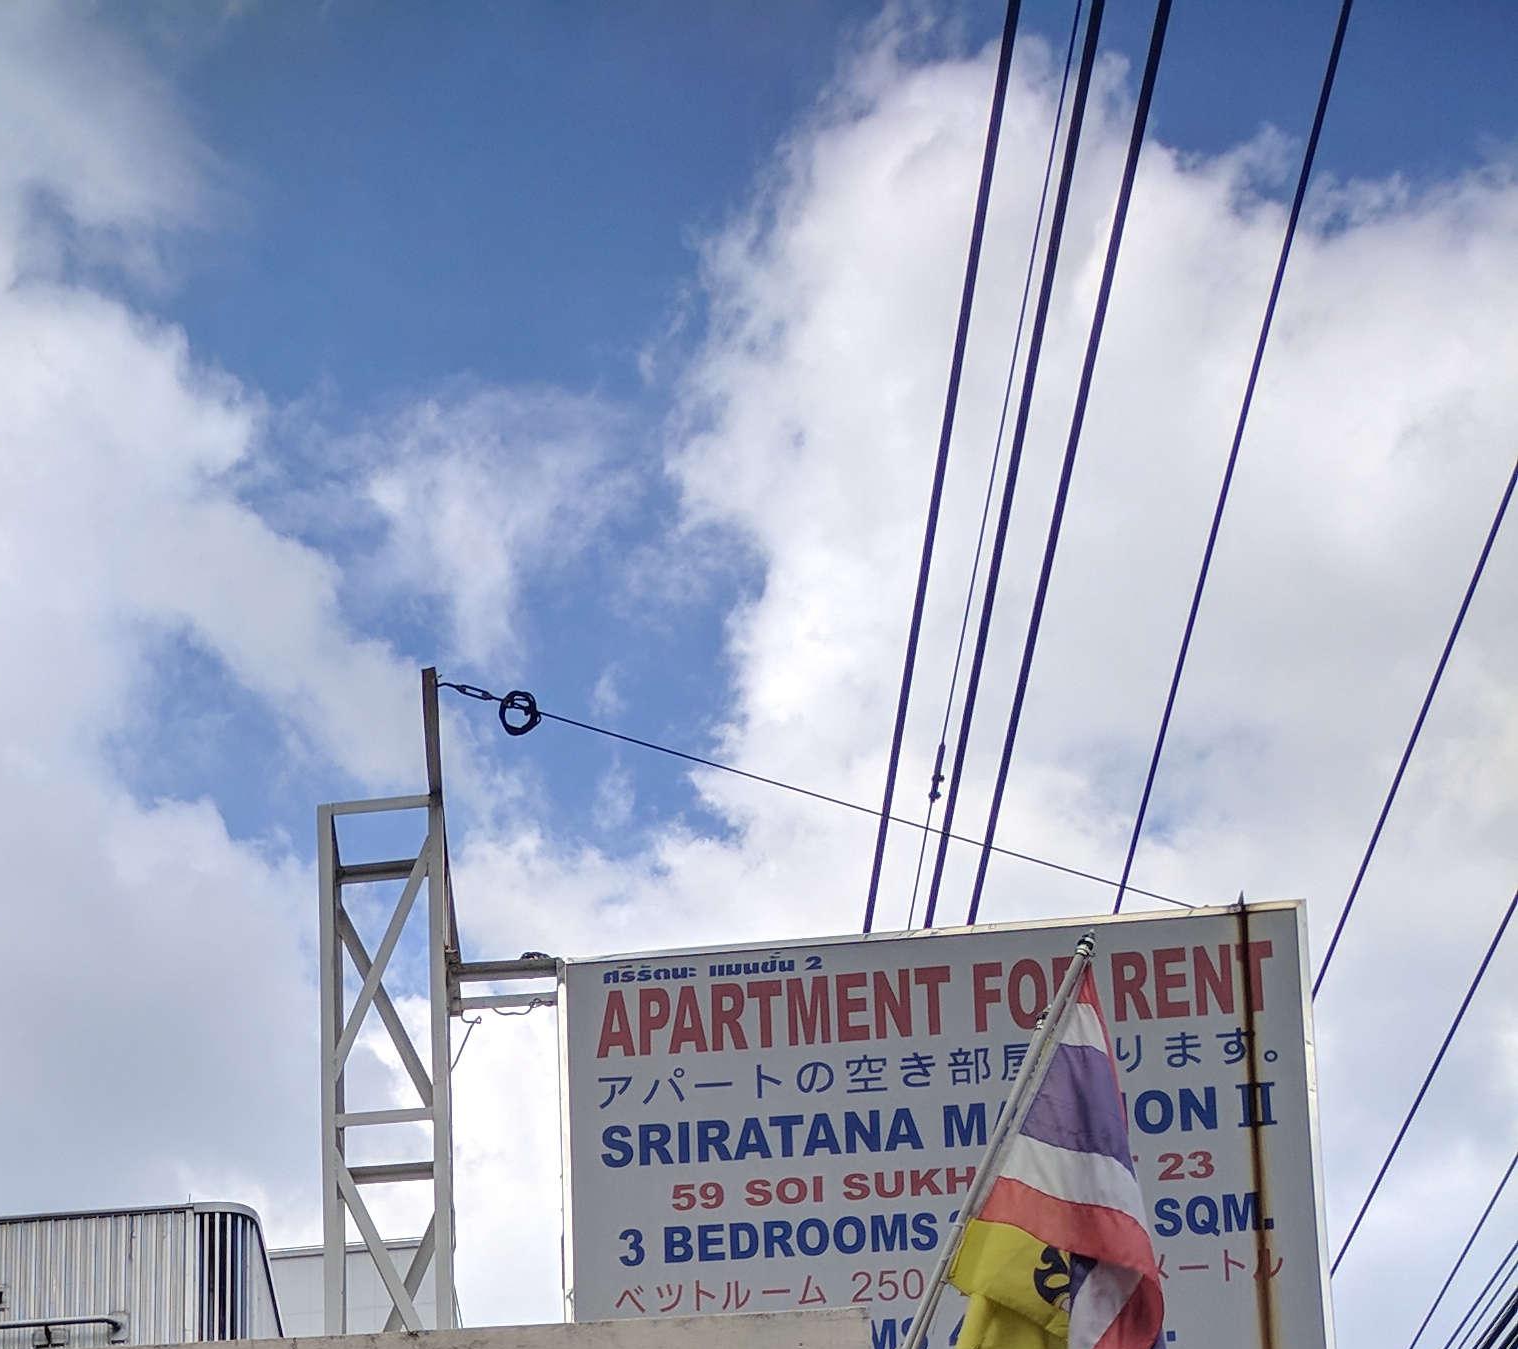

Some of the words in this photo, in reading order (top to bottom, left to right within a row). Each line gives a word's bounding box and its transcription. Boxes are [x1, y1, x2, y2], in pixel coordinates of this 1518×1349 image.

[804, 955, 823, 971] 2
[596, 965, 951, 1059] APARTMENT
[1110, 940, 1273, 1023] RENT
[600, 1107, 924, 1168] SRIRATANA
[671, 1182, 725, 1212] 59
[744, 1175, 824, 1207] SOI
[1157, 1151, 1216, 1181] 23
[618, 1228, 646, 1267] 3
[663, 1212, 939, 1266] BEDROOMS
[1153, 1192, 1275, 1237] SQM.
[851, 1268, 925, 1303] 250
